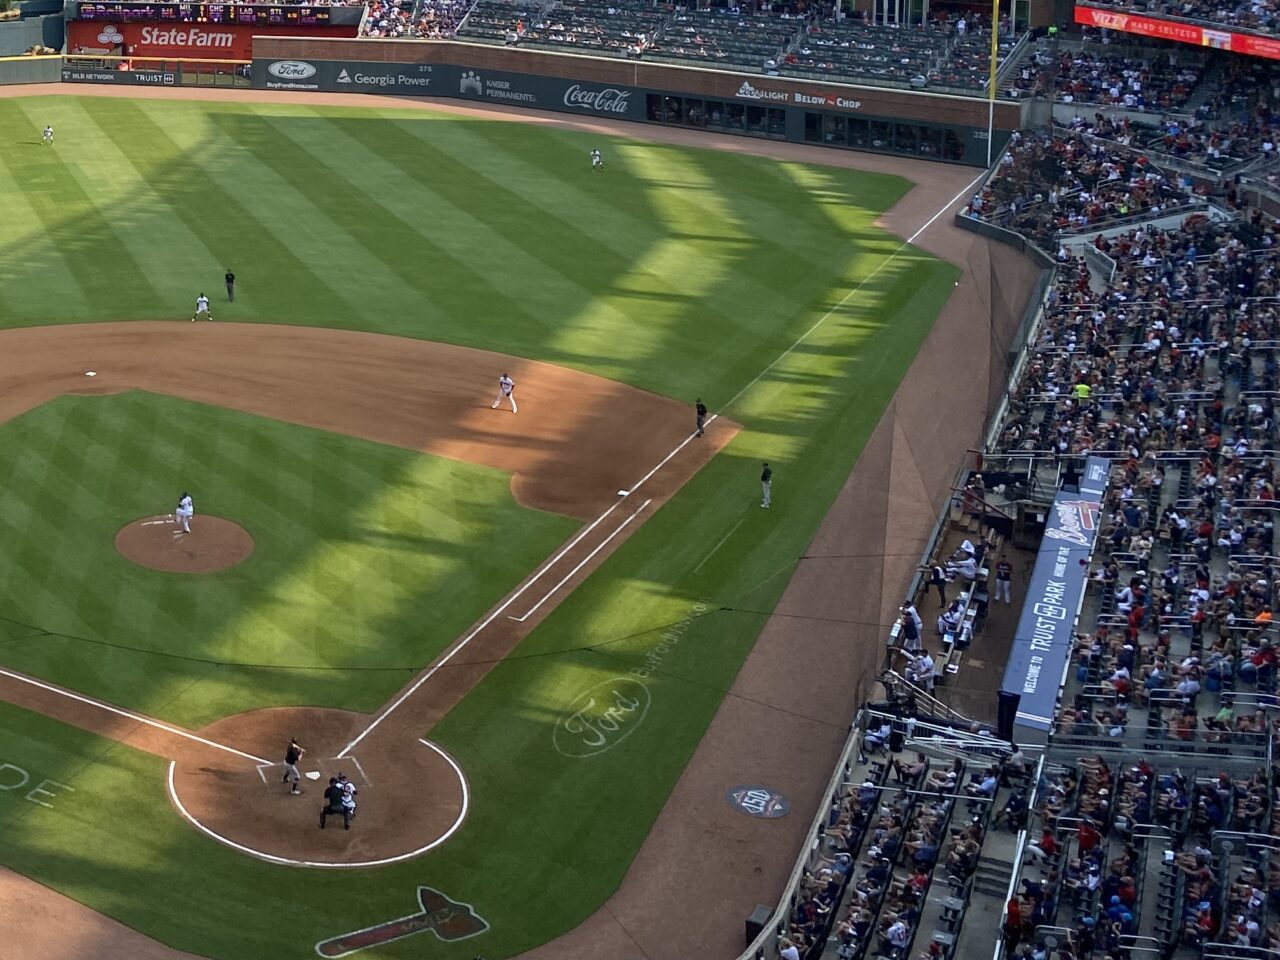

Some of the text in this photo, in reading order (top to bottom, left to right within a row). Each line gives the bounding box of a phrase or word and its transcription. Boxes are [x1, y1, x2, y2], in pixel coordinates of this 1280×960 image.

[1092, 11, 1197, 38] VIZZY HARD SELTZER
[276, 62, 307, 77] Ford
[135, 74, 163, 83] TRUIST
[354, 73, 431, 87] Georgia Power
[486, 80, 510, 90] KAISER
[486, 89, 533, 103] PERMANENTE
[563, 84, 633, 113] Coca-Cola
[764, 91, 789, 101] LIGHT
[836, 97, 861, 109] CHOP
[1023, 562, 1067, 694] WELCOME TRUIST PARK HOME
[564, 690, 640, 746] Ford
